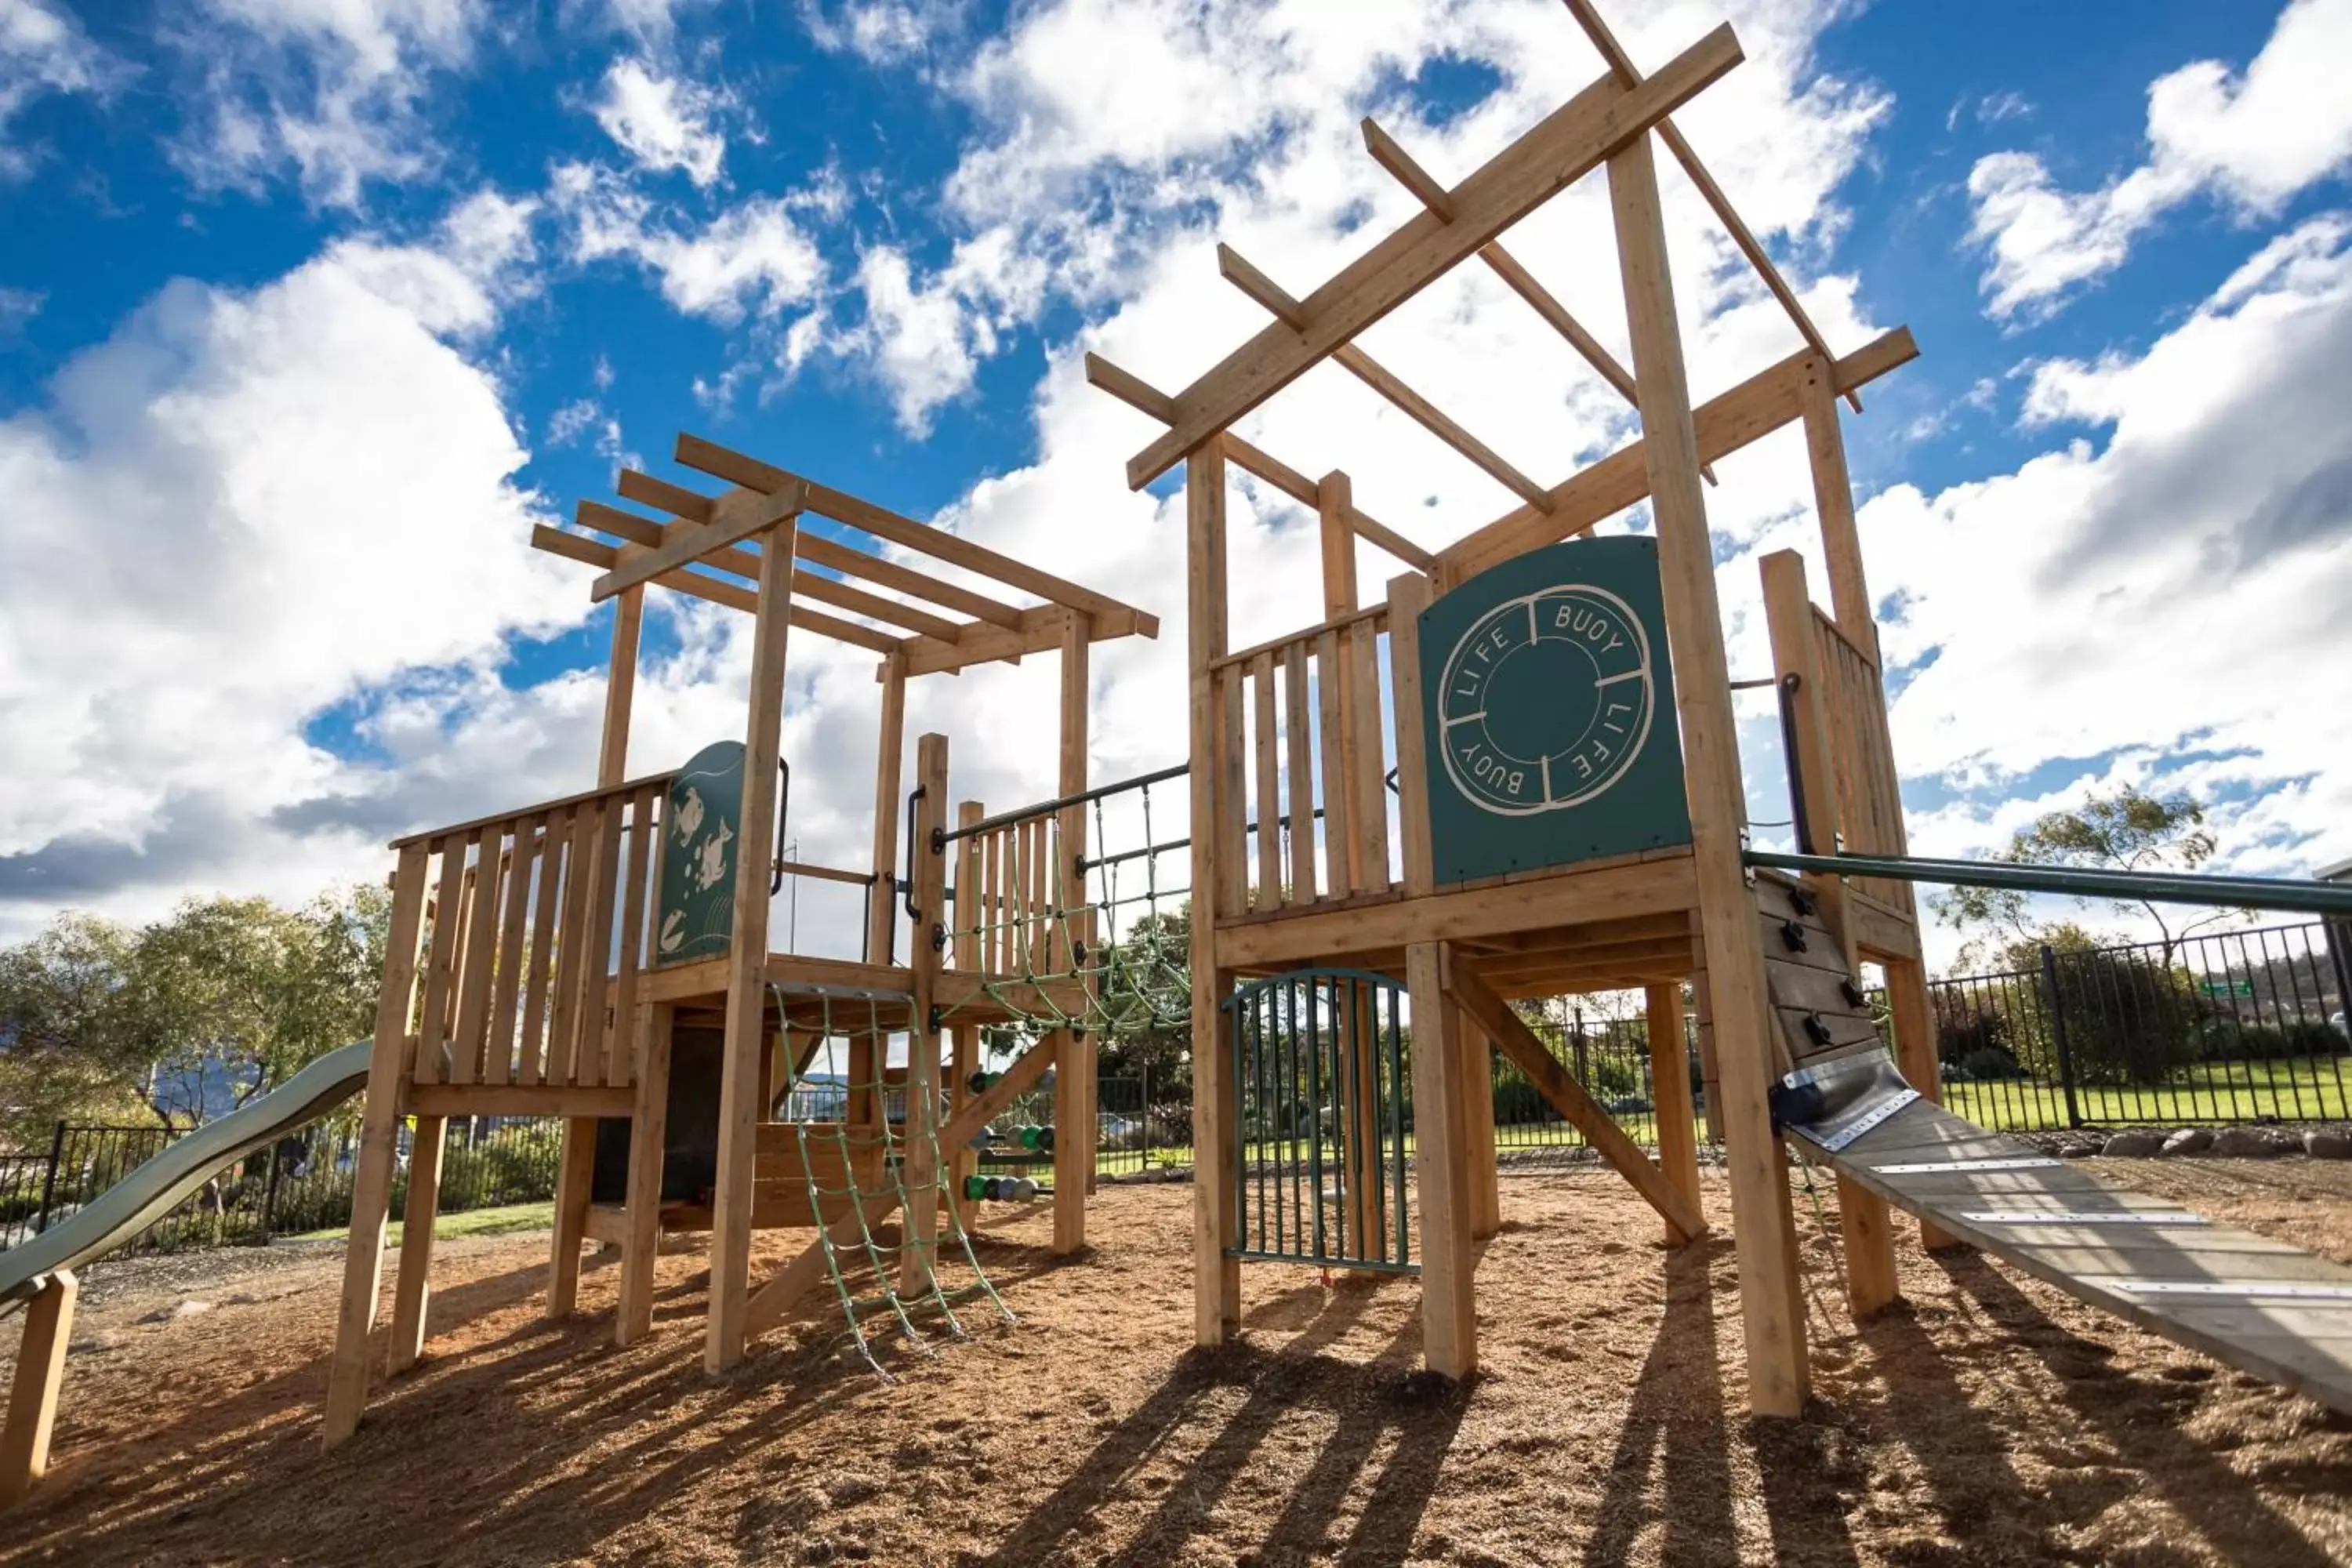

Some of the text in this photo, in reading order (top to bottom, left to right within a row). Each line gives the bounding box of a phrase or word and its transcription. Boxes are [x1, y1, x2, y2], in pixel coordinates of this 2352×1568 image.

[1457, 604, 1624, 696] LIFE BUOY
[1461, 703, 1632, 794] LIFE BUOY
